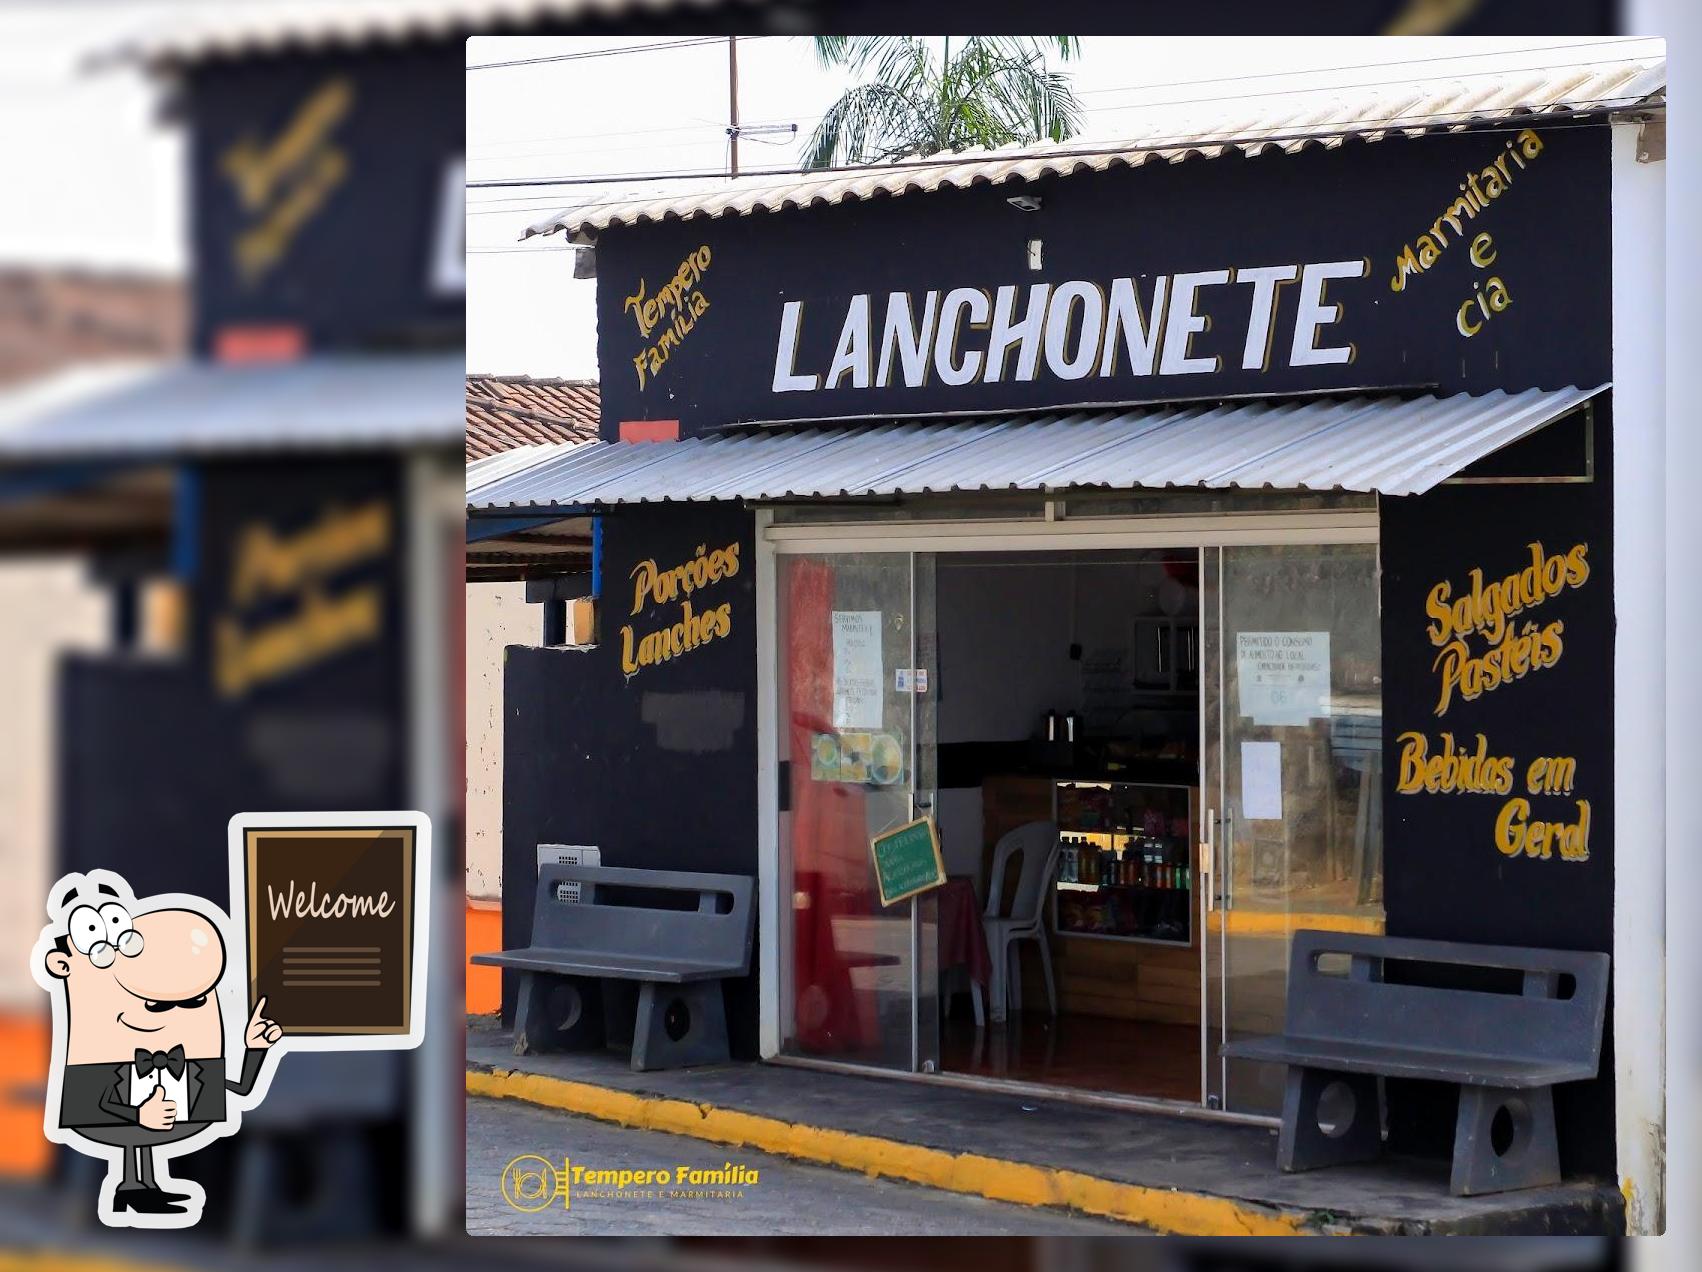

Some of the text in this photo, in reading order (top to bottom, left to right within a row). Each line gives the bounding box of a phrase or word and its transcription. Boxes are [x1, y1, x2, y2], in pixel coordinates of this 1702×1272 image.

[1391, 128, 1545, 292] Marmitaria
[1469, 232, 1497, 268] e
[624, 244, 712, 339] Tempero
[772, 257, 1370, 393] LANCHONETE
[629, 542, 740, 616] Porções
[1425, 540, 1590, 646] Salgados
[620, 599, 731, 683] Lanches
[1432, 618, 1564, 717] Pastéis
[1396, 731, 1577, 796] Bebidas em
[1495, 797, 1592, 862] Geral
